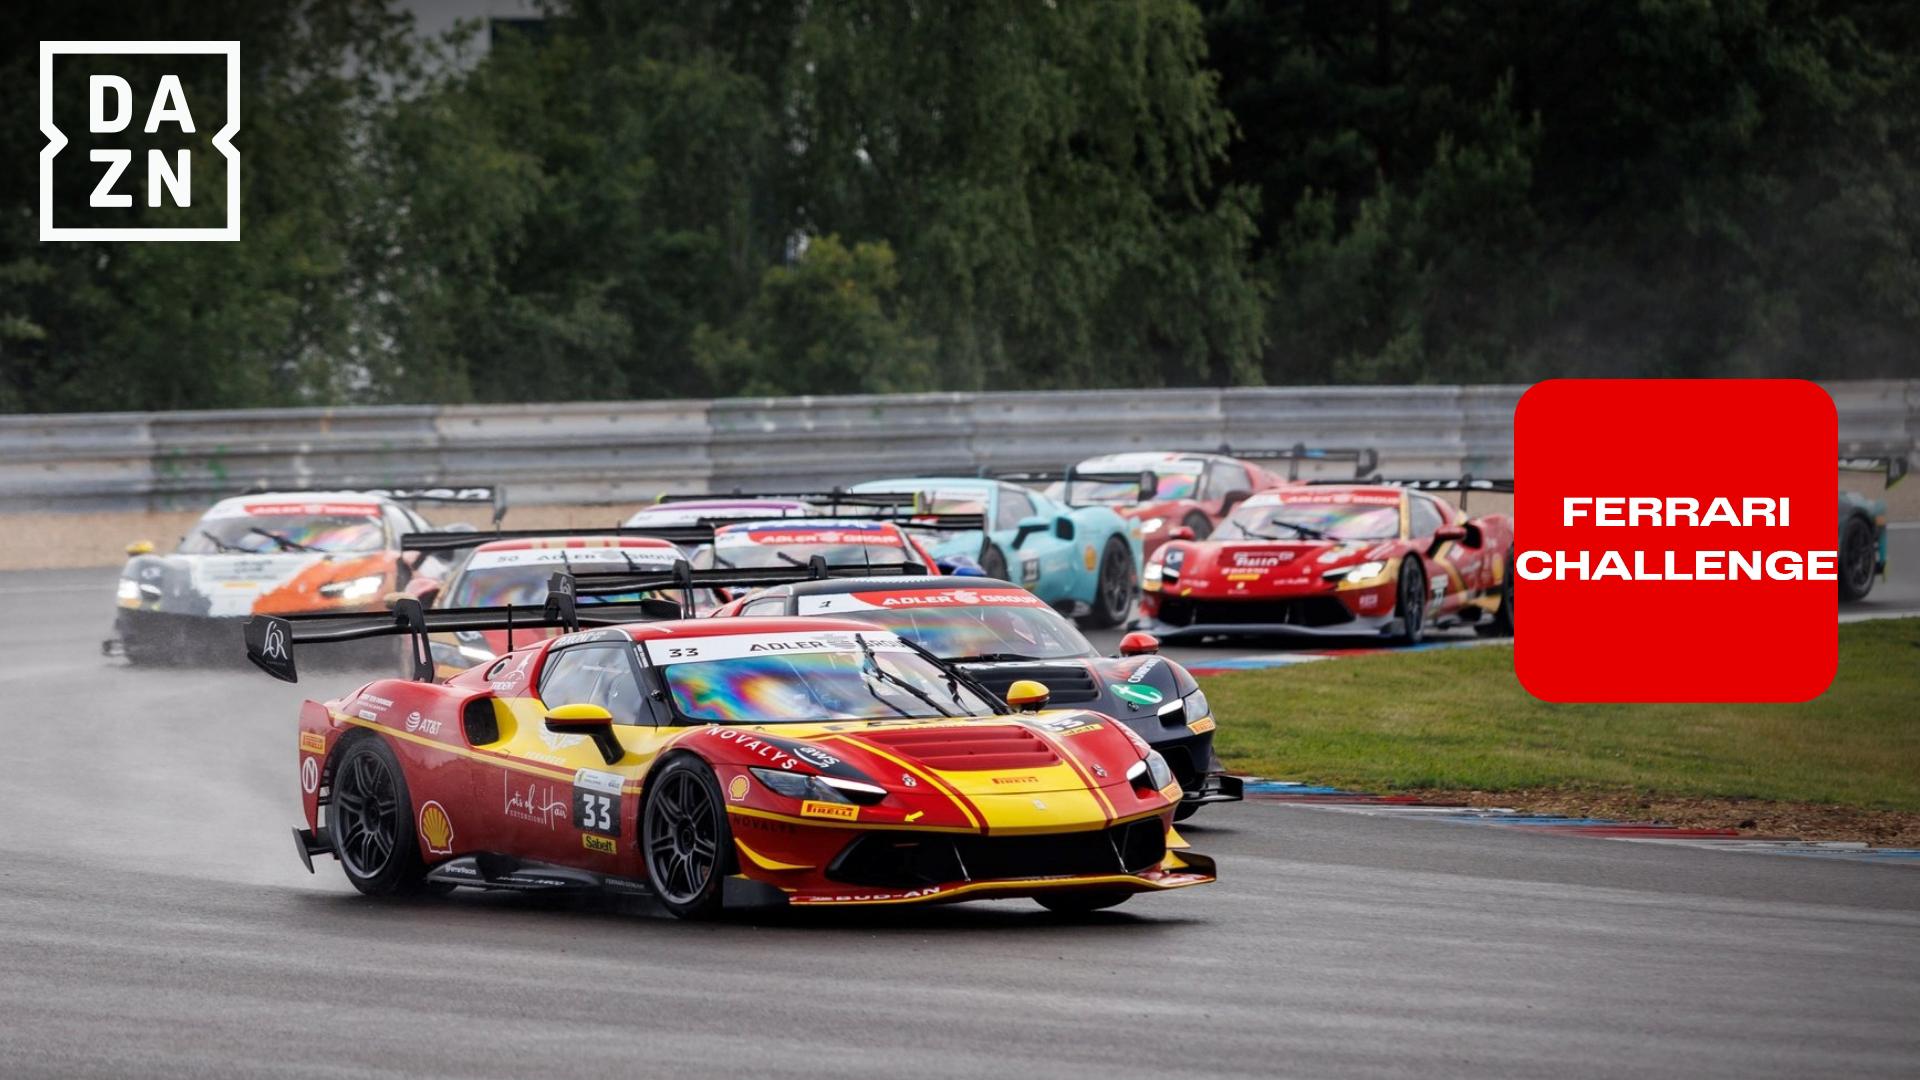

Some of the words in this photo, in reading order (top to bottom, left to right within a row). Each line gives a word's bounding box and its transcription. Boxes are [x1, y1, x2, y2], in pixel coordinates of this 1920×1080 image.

[882, 594, 953, 605] ADLER
[669, 647, 699, 658] 33
[750, 640, 824, 652] ADLER
[418, 719, 442, 736] AT&T
[706, 726, 798, 770] NOVALYS
[800, 746, 840, 765] aws
[583, 793, 611, 830] 33
[807, 803, 853, 817] PIRELLI
[585, 835, 612, 852] Sabelt
